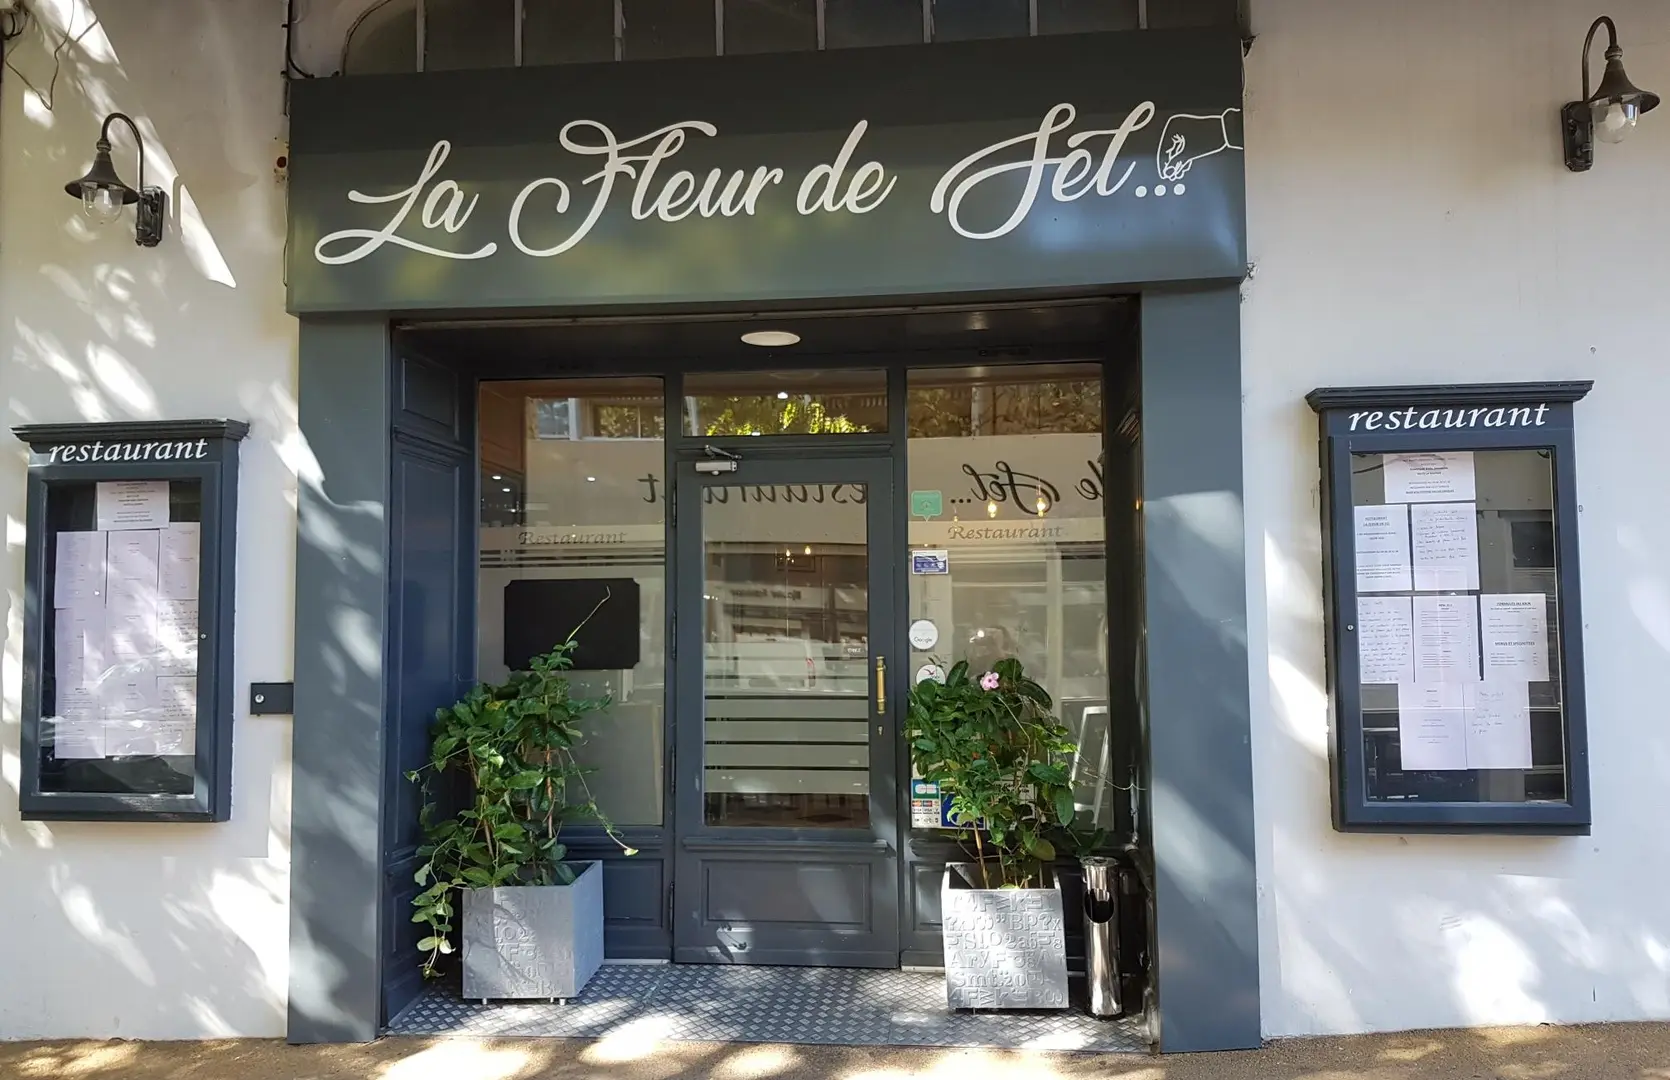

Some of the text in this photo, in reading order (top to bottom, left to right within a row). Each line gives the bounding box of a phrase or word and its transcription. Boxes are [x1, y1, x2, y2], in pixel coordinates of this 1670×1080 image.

[315, 140, 497, 264] La
[508, 119, 781, 258] Fleur
[797, 119, 898, 216] de
[1348, 403, 1550, 431] restaurant
[49, 438, 209, 463] restaurant
[518, 531, 627, 545] Restaurant
[948, 525, 1064, 540] Restaurant
